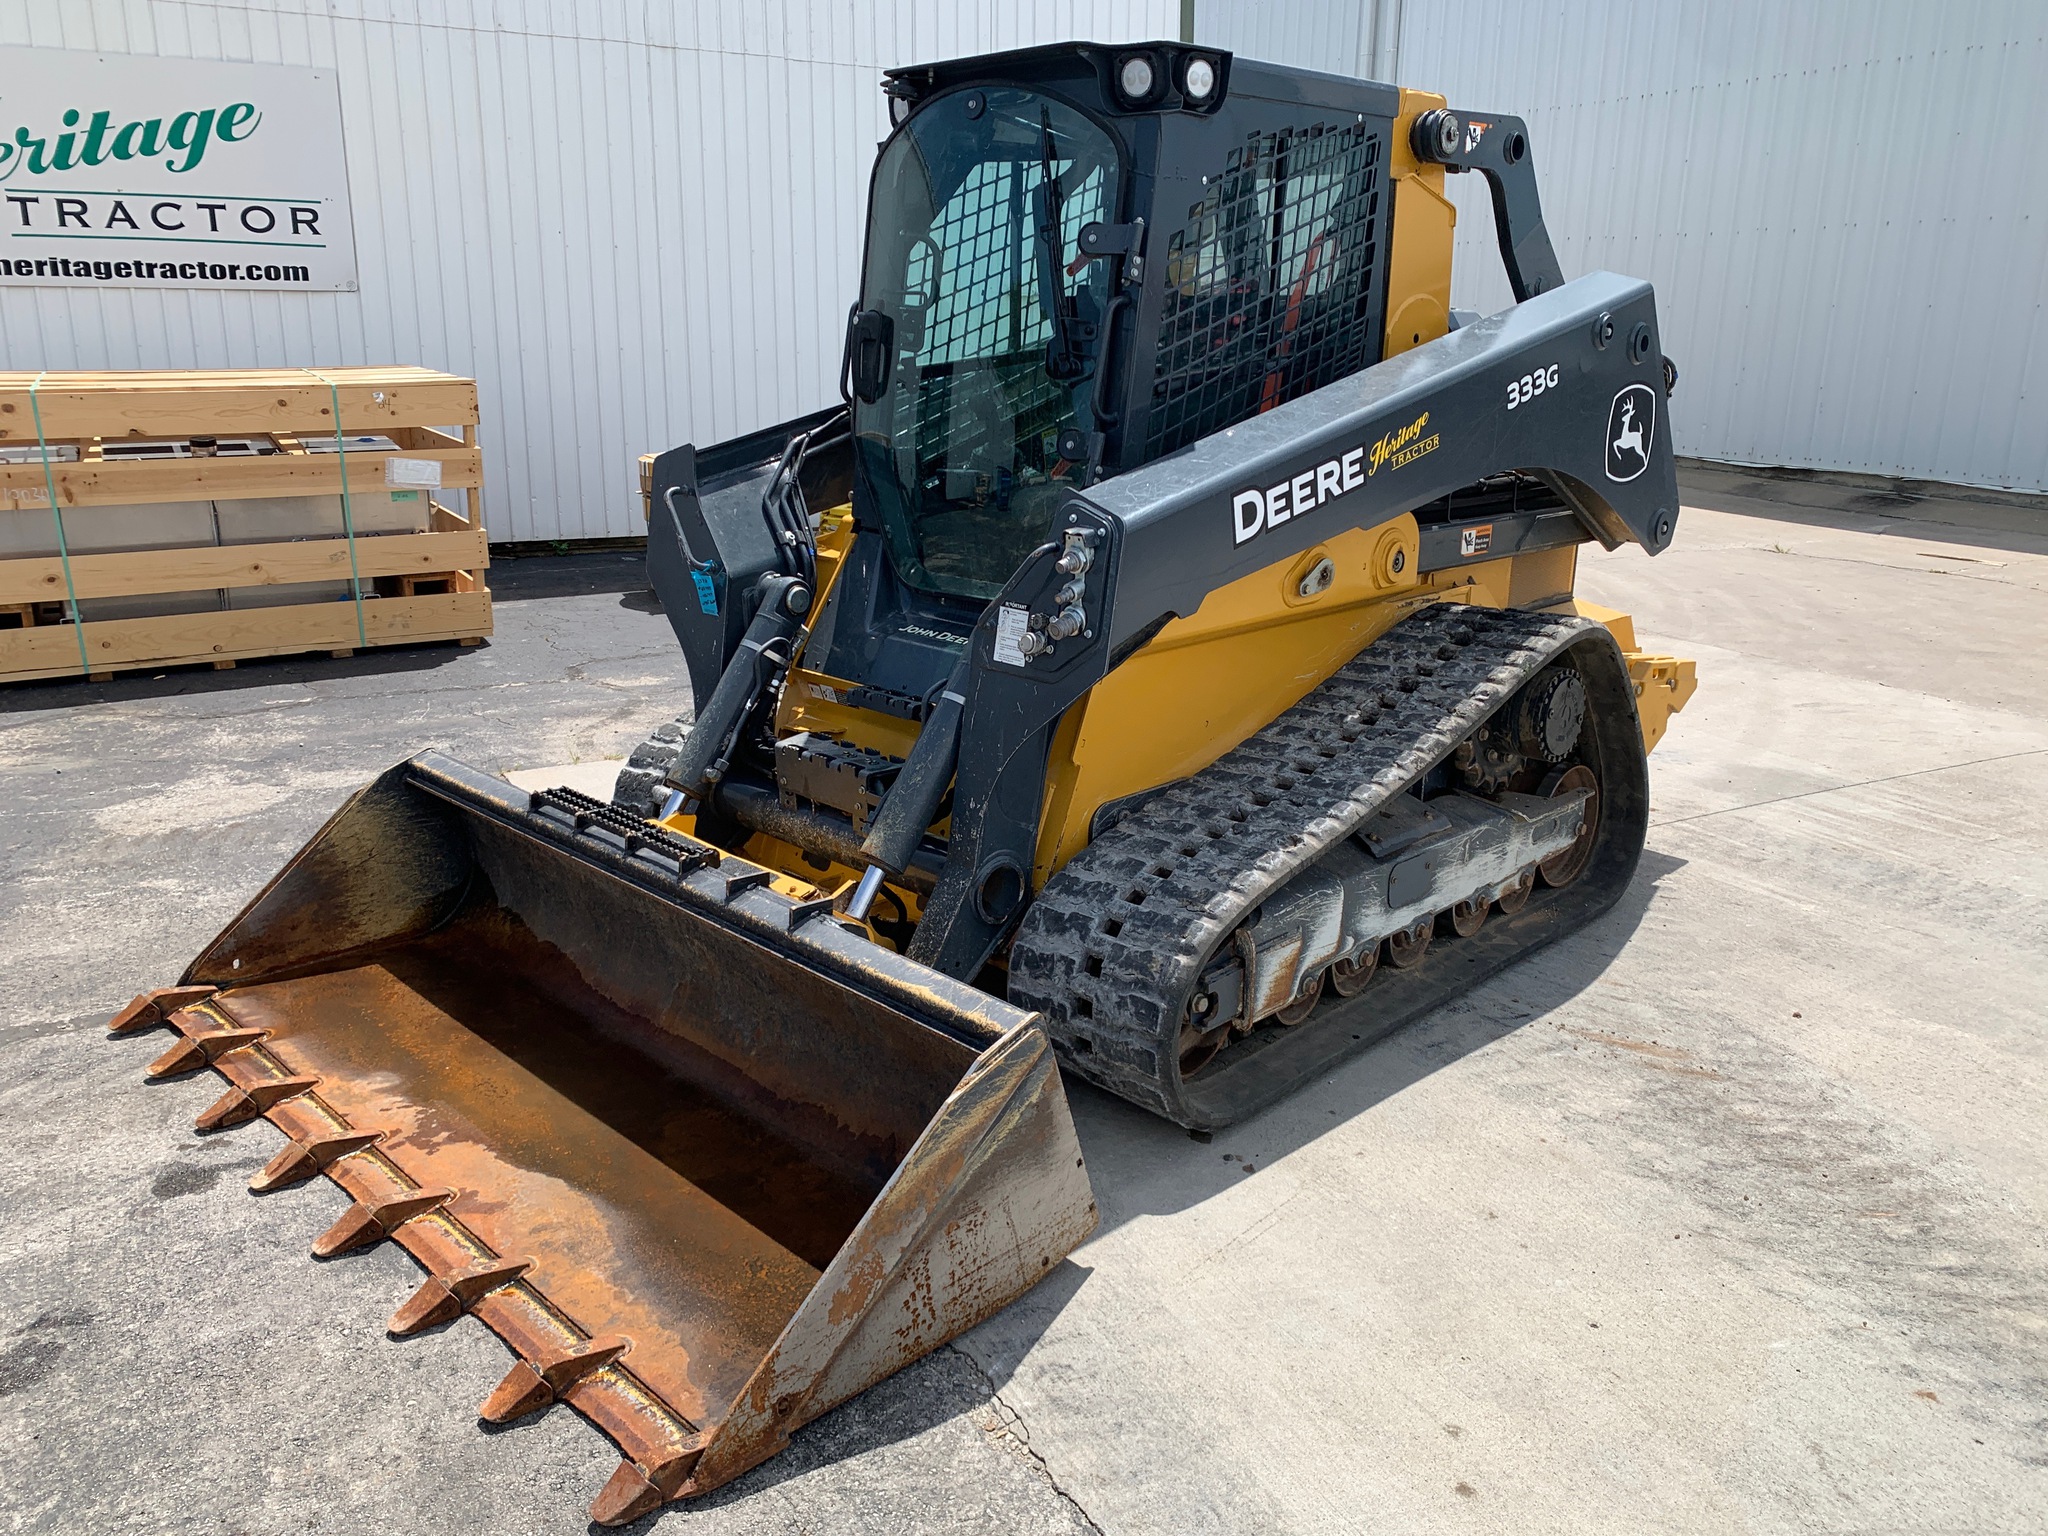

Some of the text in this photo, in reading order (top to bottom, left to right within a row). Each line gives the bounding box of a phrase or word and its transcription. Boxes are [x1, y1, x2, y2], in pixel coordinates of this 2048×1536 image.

[6, 195, 322, 236] TRACTOR
[1507, 363, 1559, 410] 333G
[1368, 411, 1430, 477] Heritage
[1391, 435, 1440, 467] TRACTOR
[1233, 446, 1365, 545] DEERE
[898, 624, 969, 645] JOHN DEE
